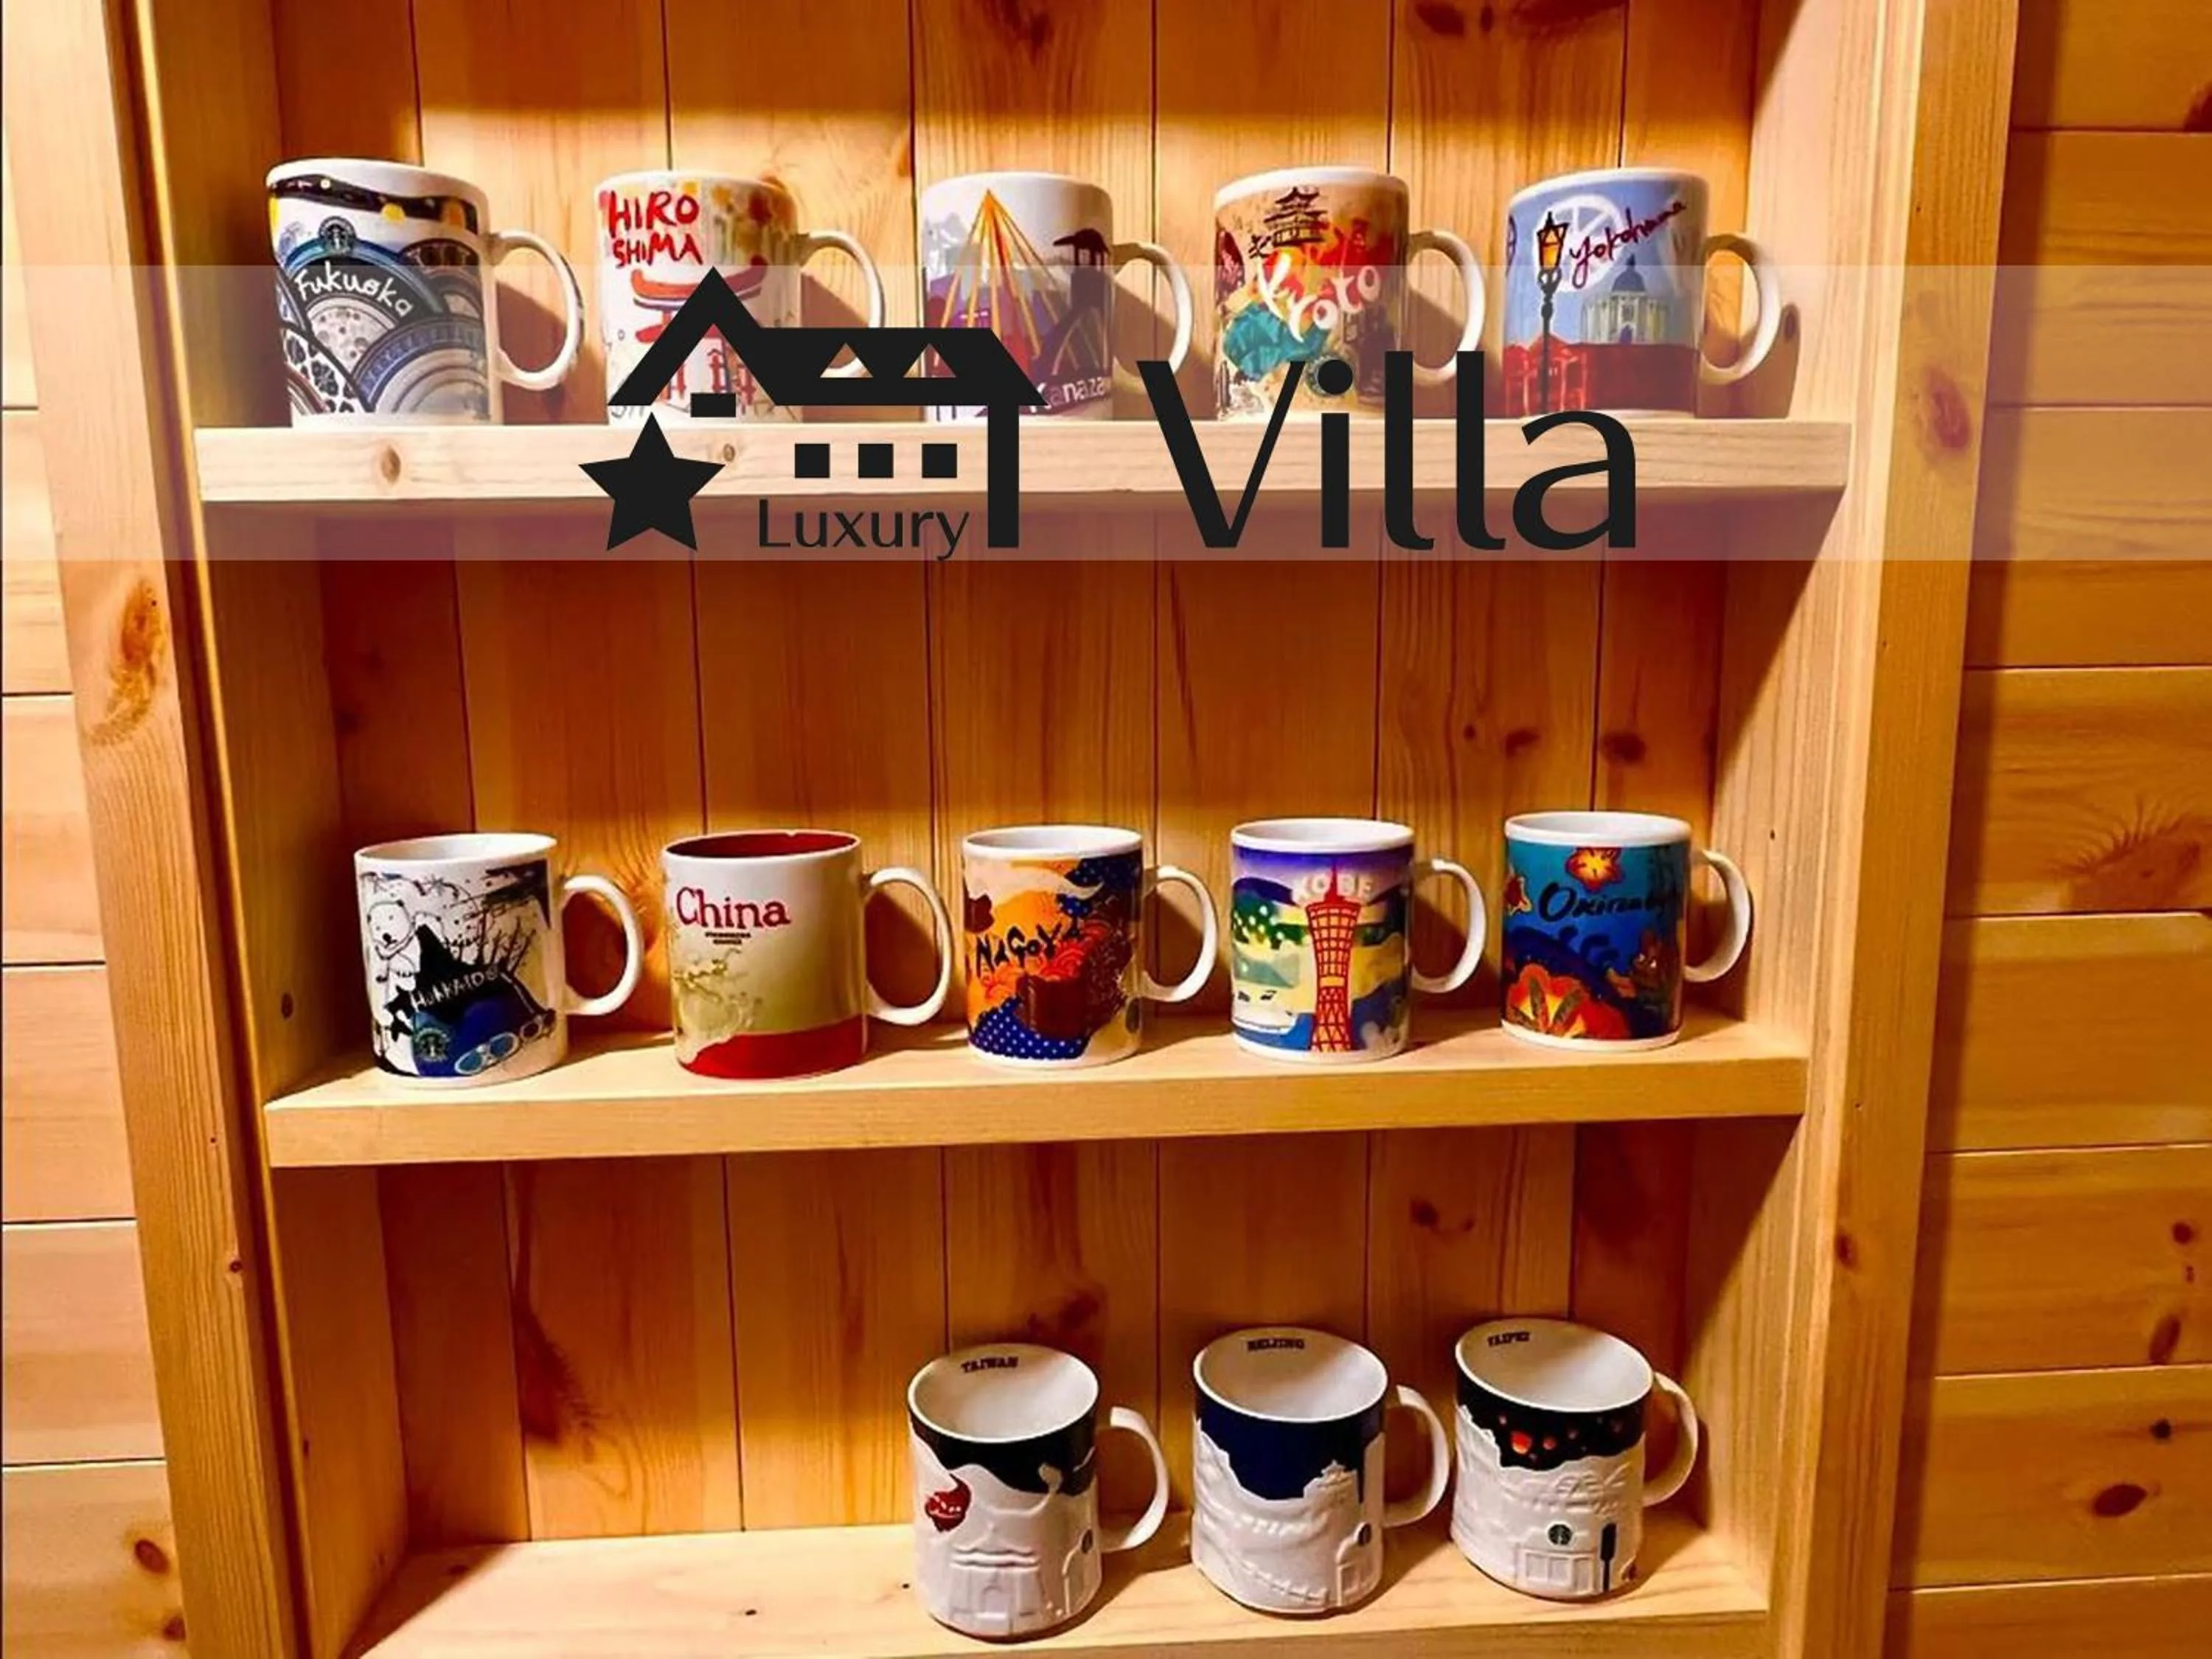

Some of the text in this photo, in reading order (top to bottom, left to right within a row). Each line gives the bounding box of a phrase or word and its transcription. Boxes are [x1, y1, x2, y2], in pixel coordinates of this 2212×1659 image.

[608, 190, 700, 237] HIRO
[613, 232, 703, 267] SHIMA
[293, 260, 413, 317] Fukuoka
[676, 886, 792, 929] China
